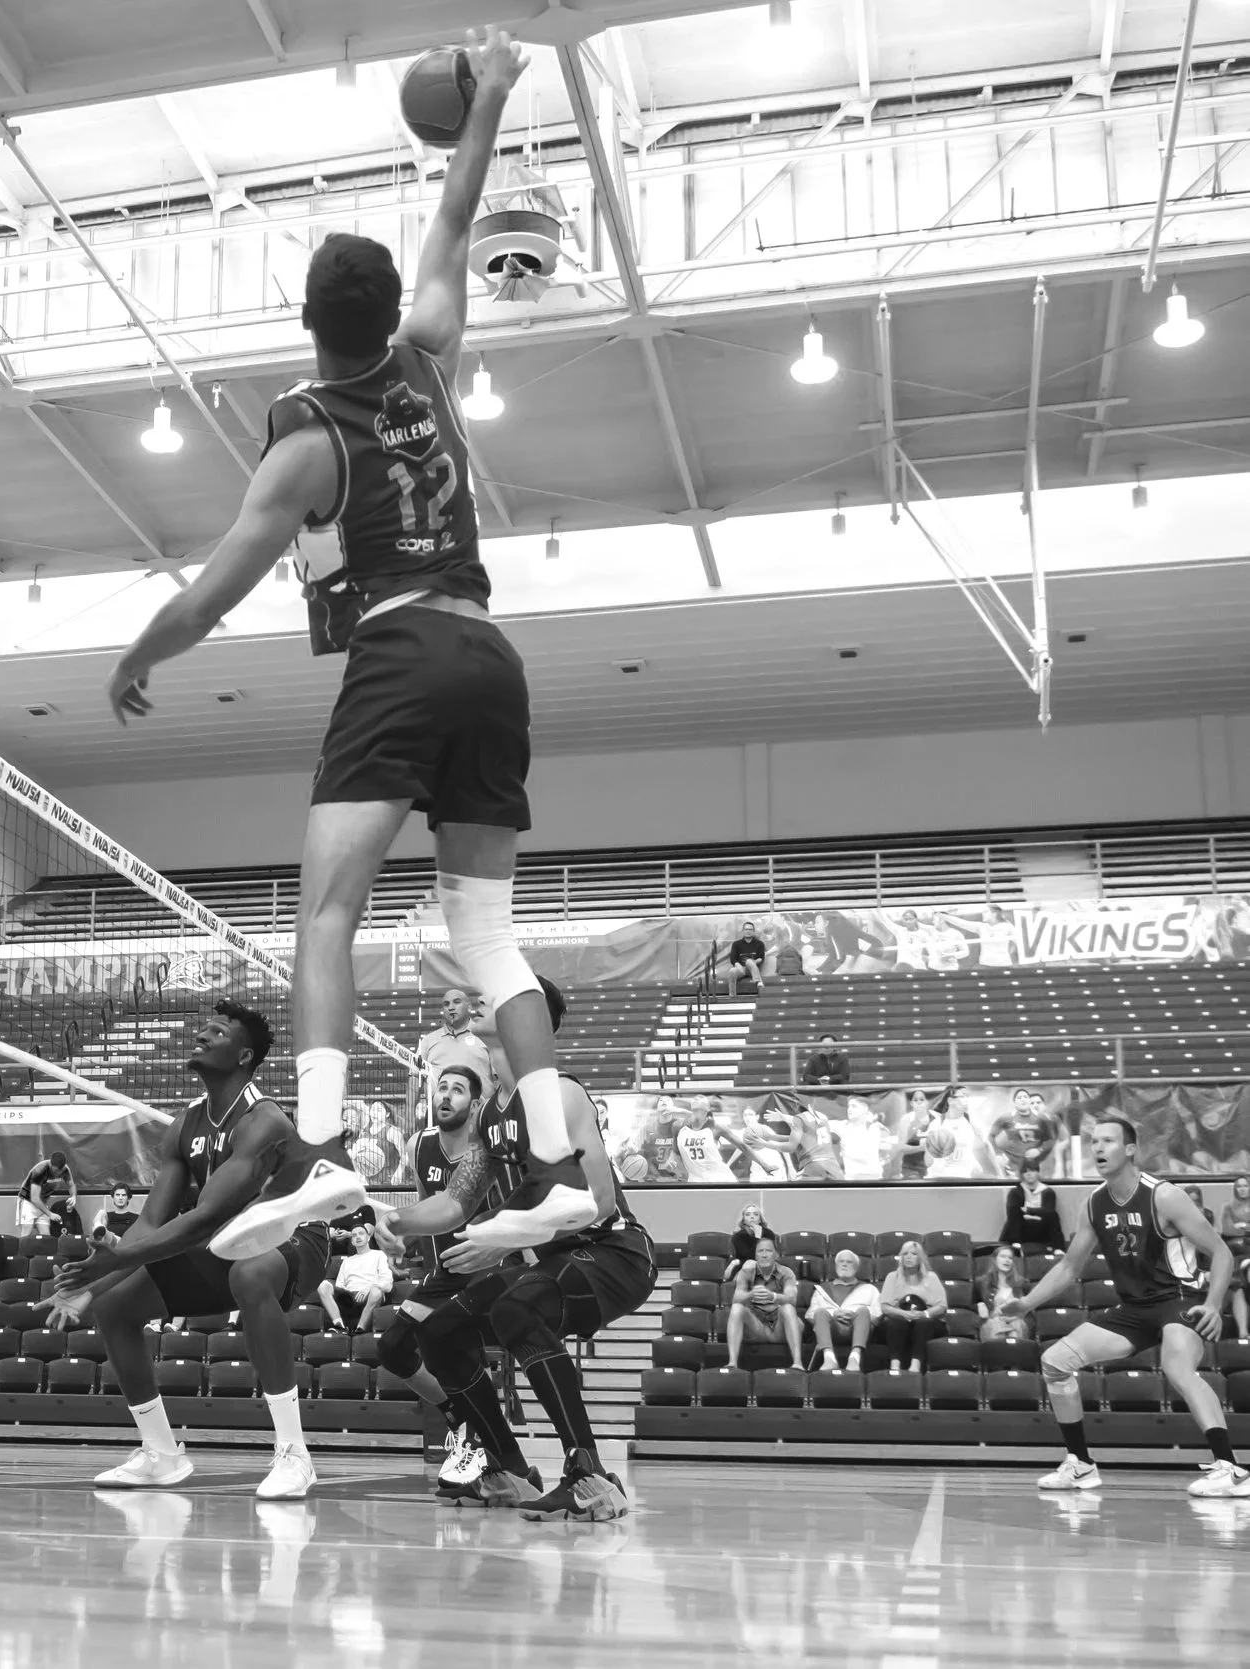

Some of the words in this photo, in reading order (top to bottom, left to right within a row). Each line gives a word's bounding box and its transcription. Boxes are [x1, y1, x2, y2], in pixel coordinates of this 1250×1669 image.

[387, 452, 458, 531] 12
[360, 931, 431, 939] LEYBALL
[1017, 910, 1192, 958] VIKINGS
[537, 937, 590, 945] CHAMPIONS
[399, 943, 424, 951] STATE
[689, 1148, 705, 1160] 33
